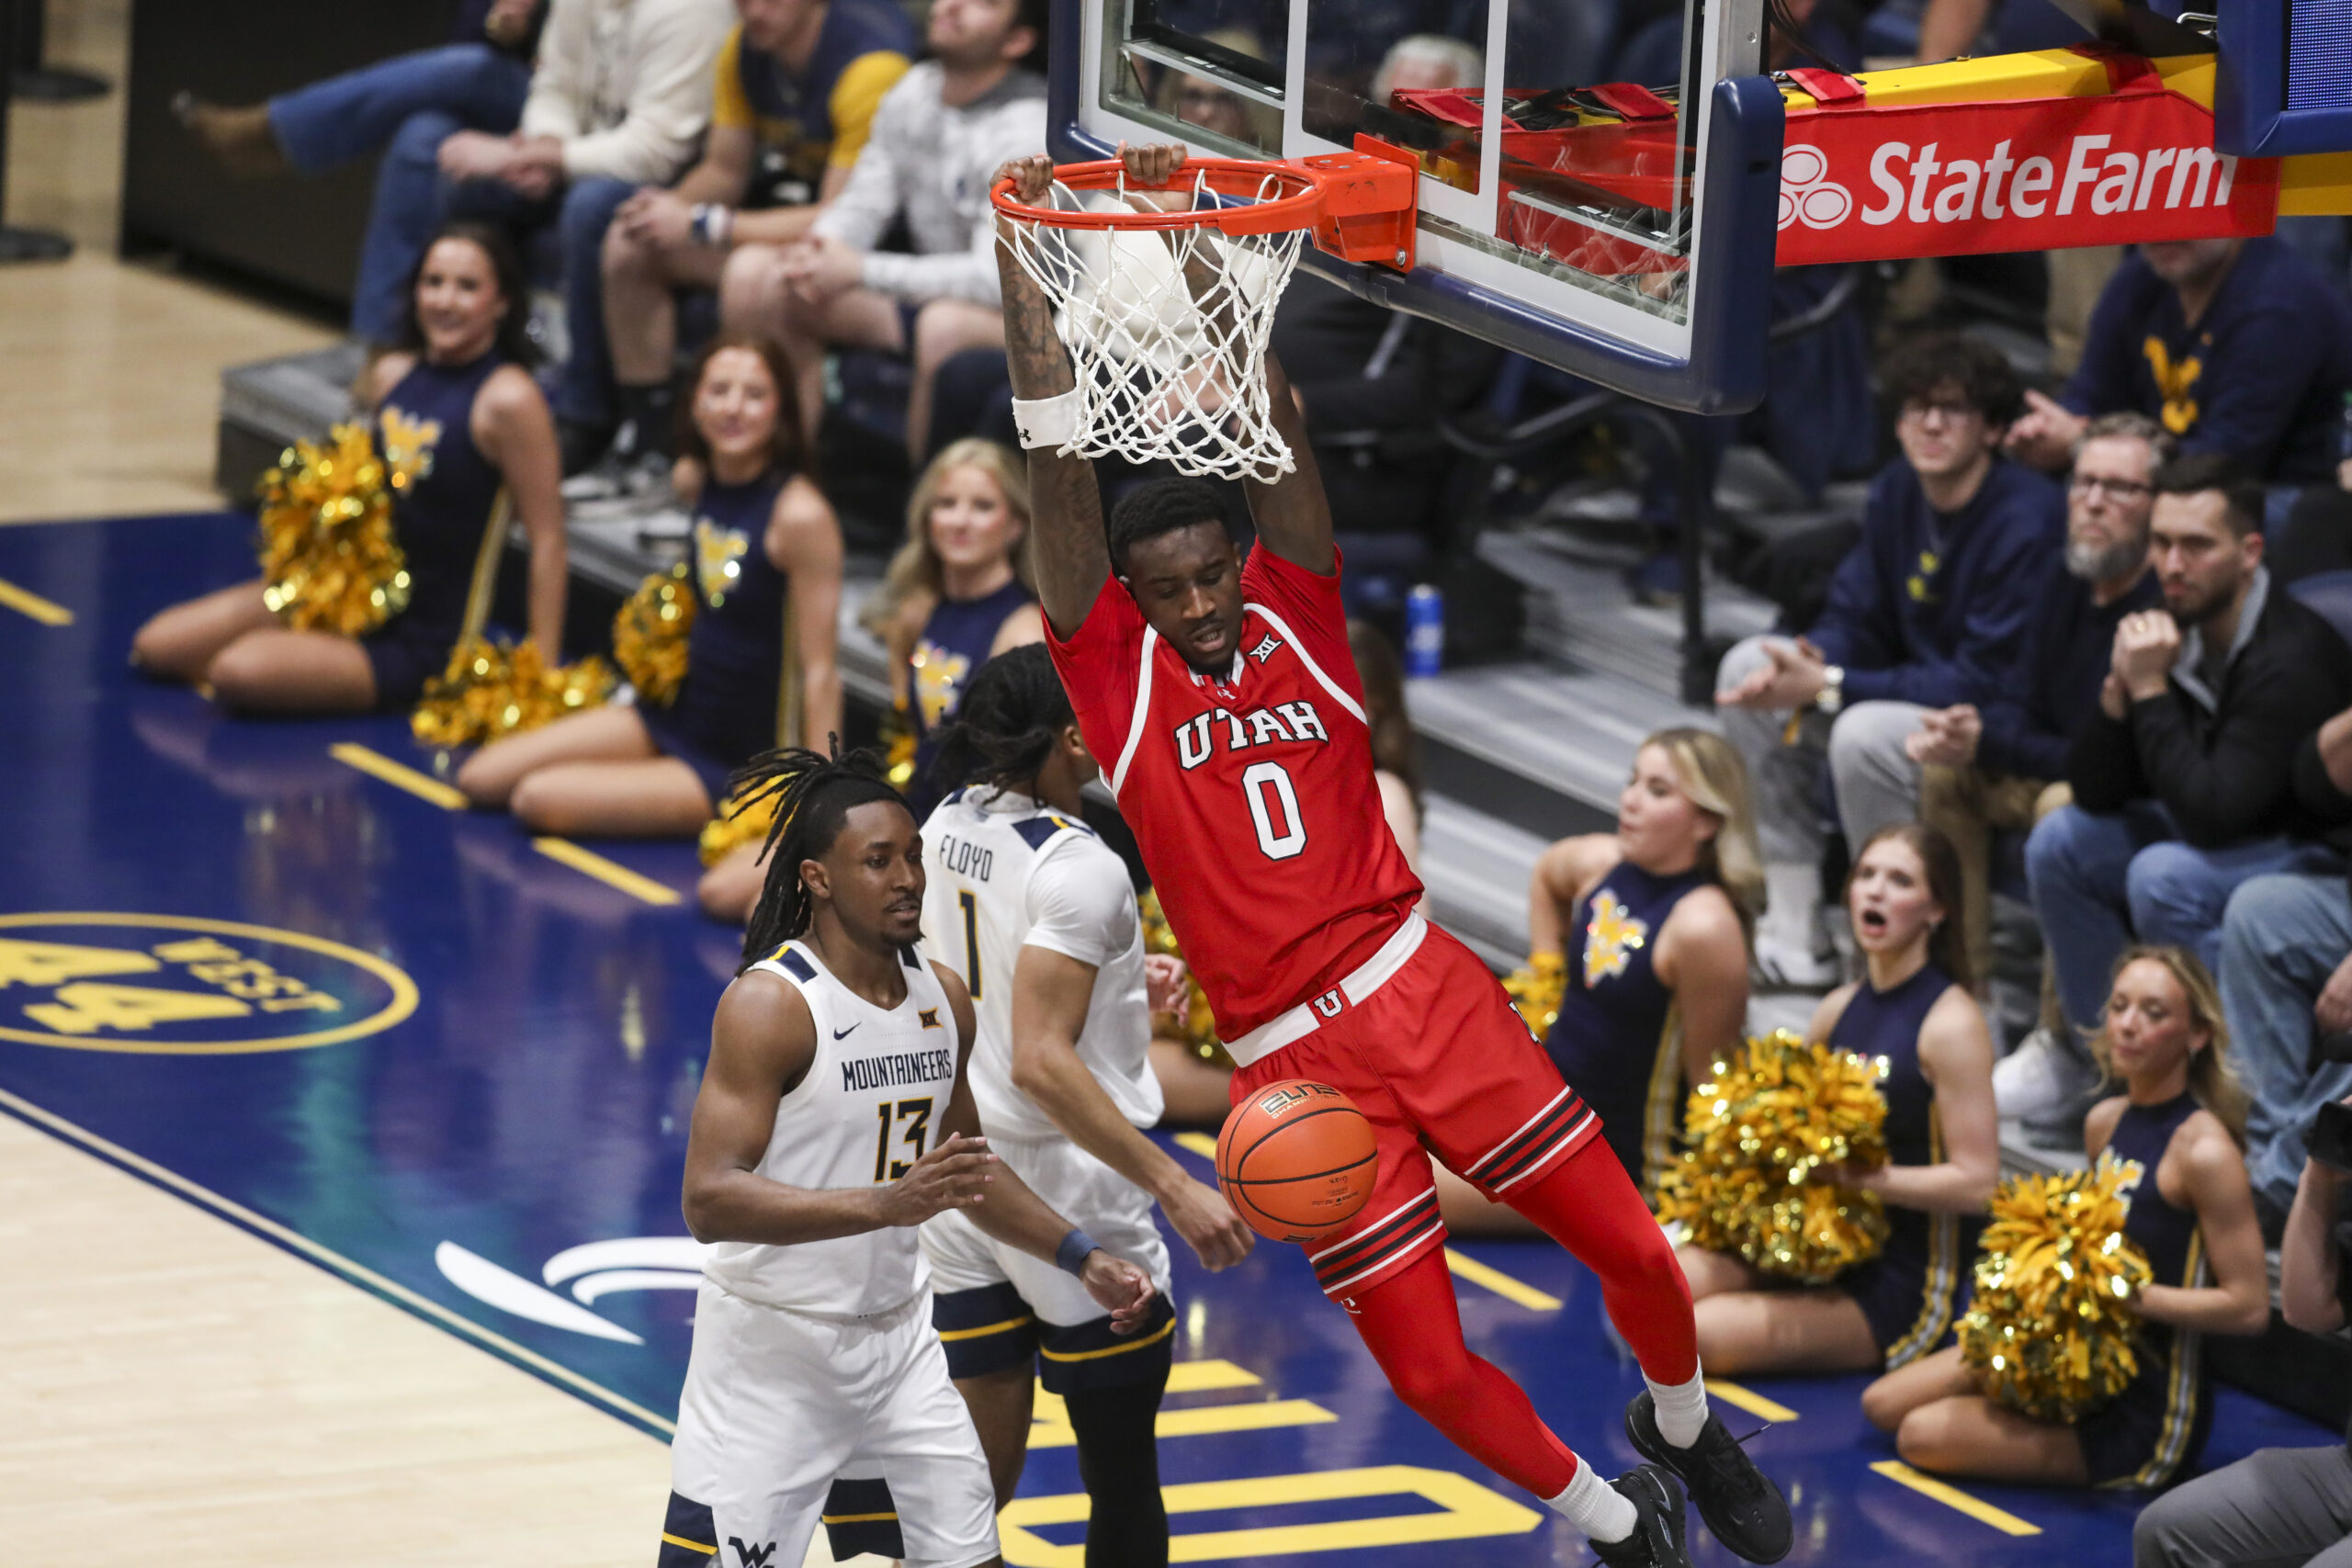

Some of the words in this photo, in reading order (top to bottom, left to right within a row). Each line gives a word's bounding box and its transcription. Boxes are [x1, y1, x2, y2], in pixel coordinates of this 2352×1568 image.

[1174, 700, 1329, 771] UTAH
[1242, 761, 1308, 861] 0
[940, 835, 993, 882] FLOYD
[153, 937, 342, 1012] WEST
[958, 889, 982, 1000] 1
[1313, 988, 1343, 1018] U
[842, 1049, 952, 1091] MOUNTAINEERS
[1260, 1084, 1340, 1114] ELITE
[875, 1096, 933, 1183] 13
